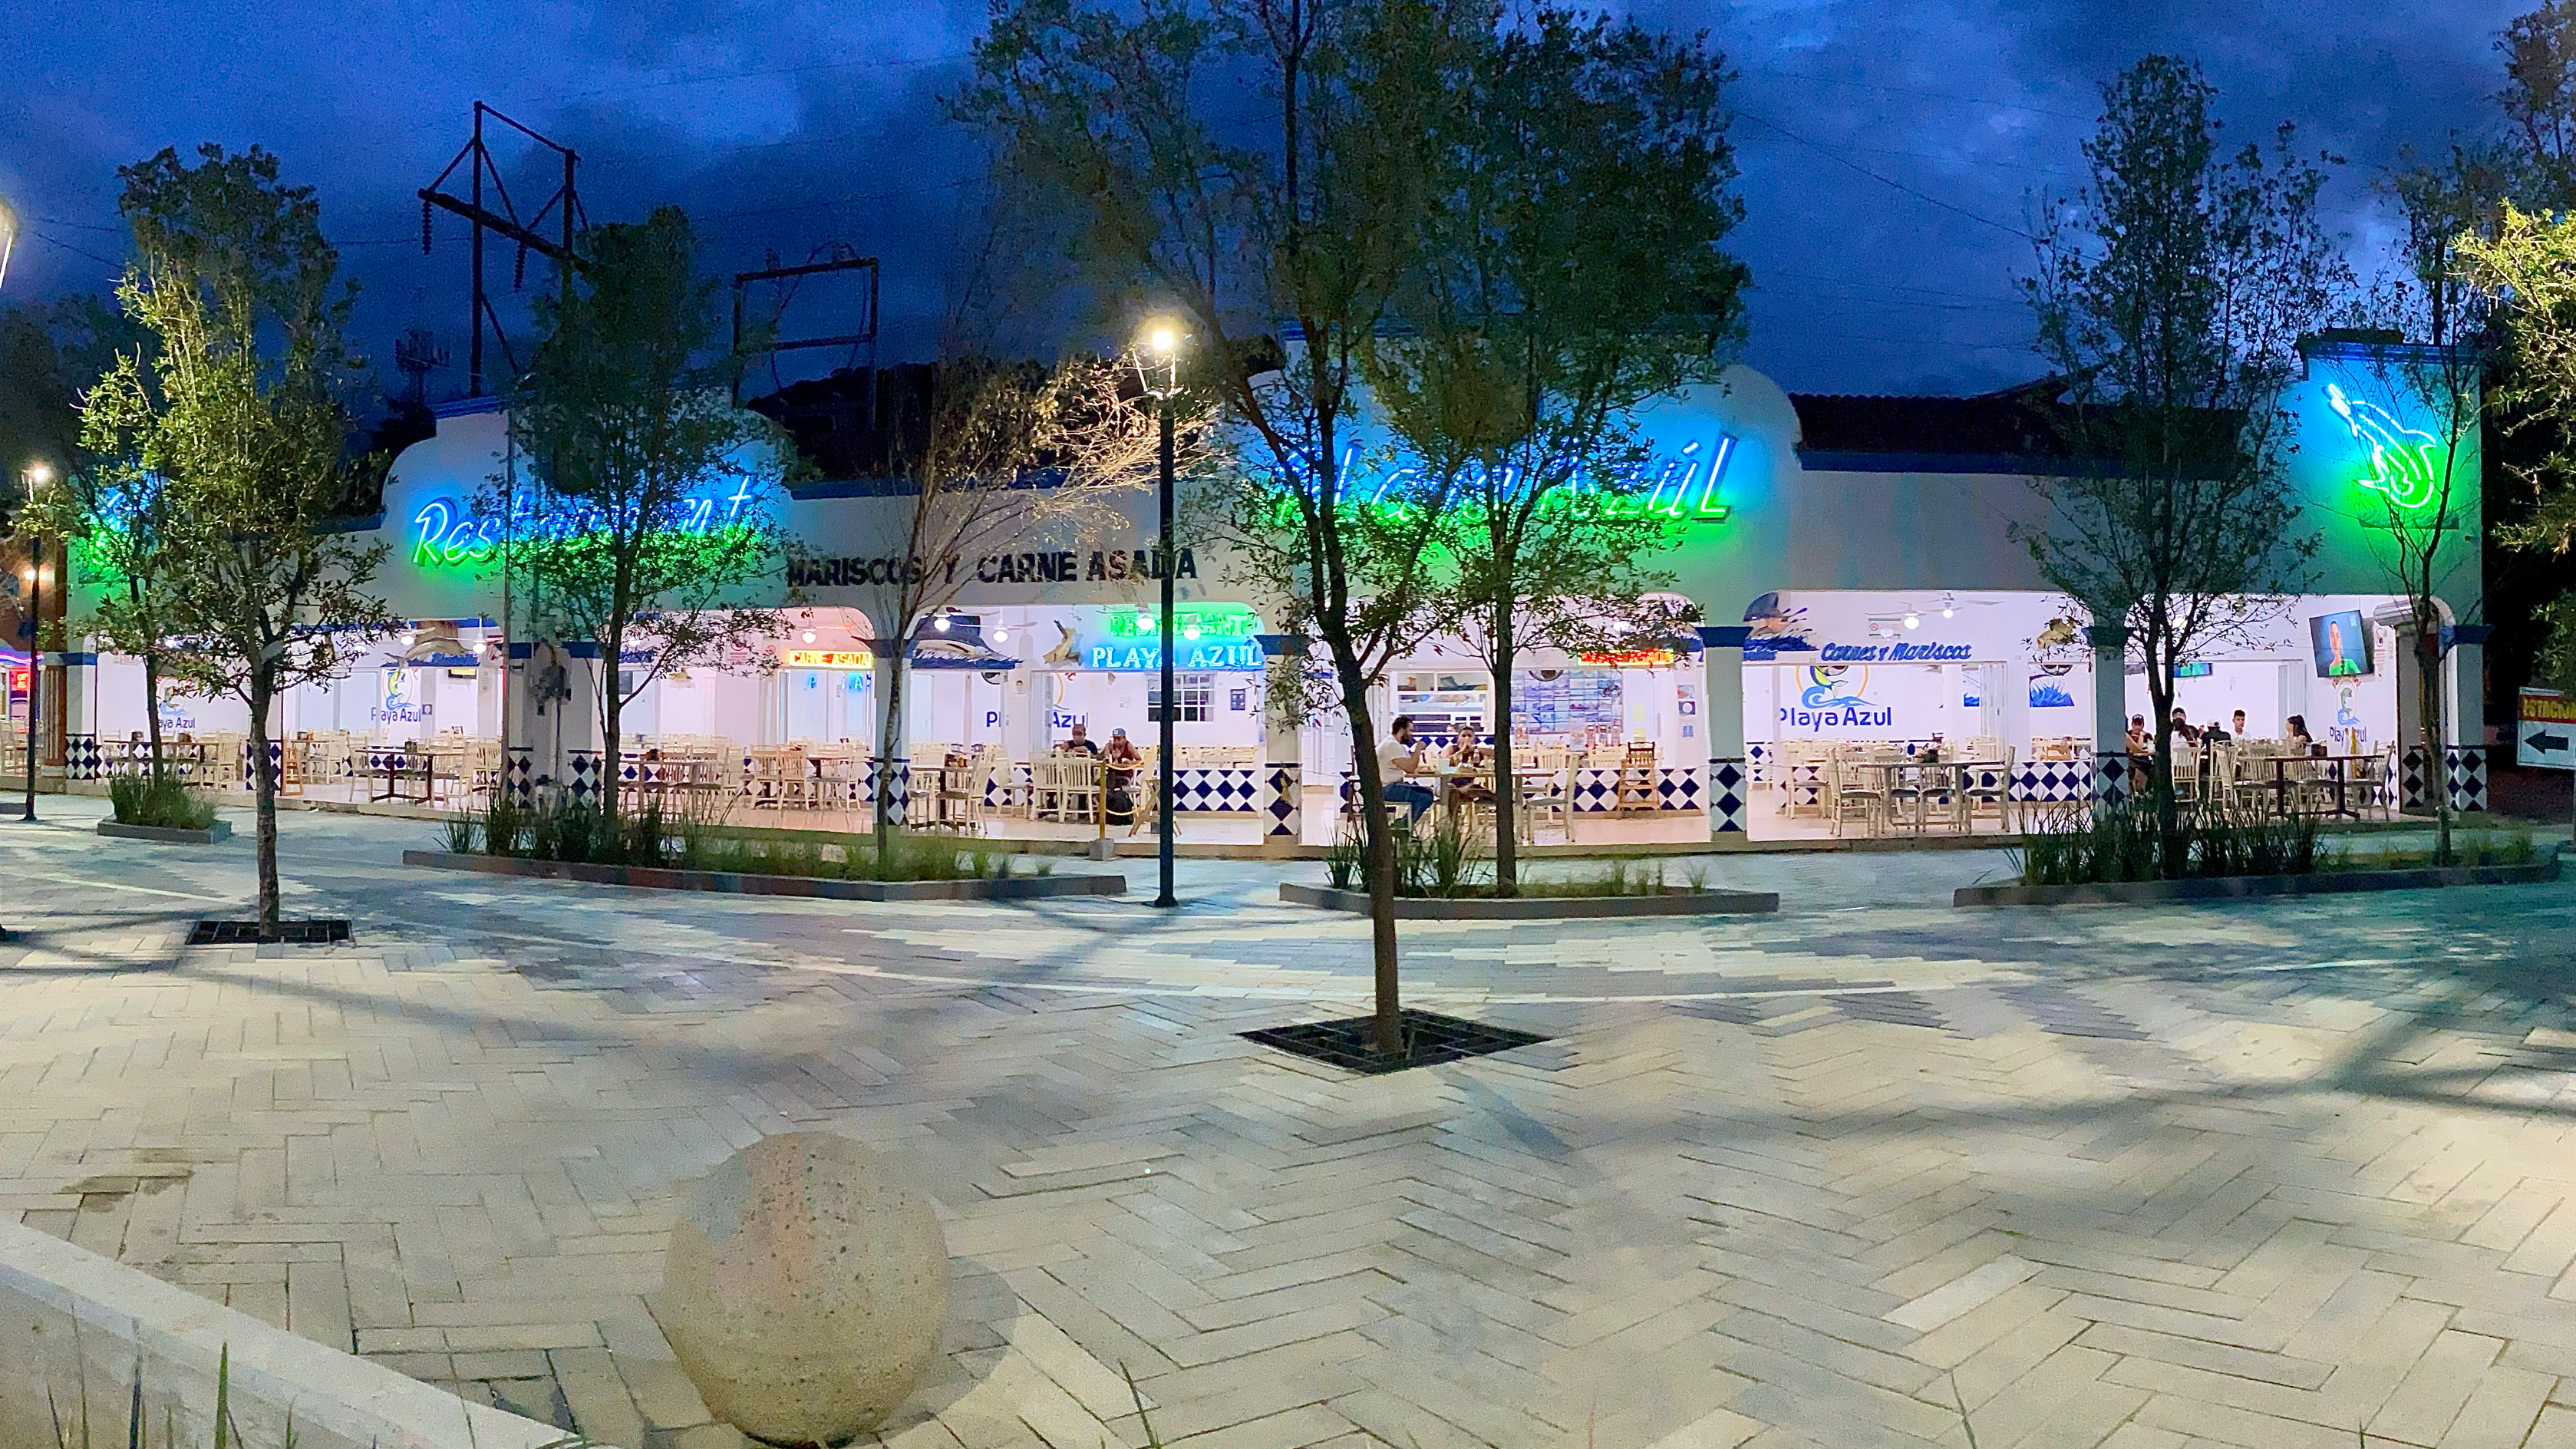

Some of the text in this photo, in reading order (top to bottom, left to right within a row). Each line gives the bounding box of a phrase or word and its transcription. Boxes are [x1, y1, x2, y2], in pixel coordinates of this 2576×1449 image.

[976, 551, 1078, 583] CARNE
[1110, 613, 1248, 636] RESTURANT
[1092, 645, 1263, 668] PLAY AZUL
[175, 716, 196, 729] Azul
[371, 707, 421, 725] Paya Azul
[1842, 706, 1892, 726] Azul
